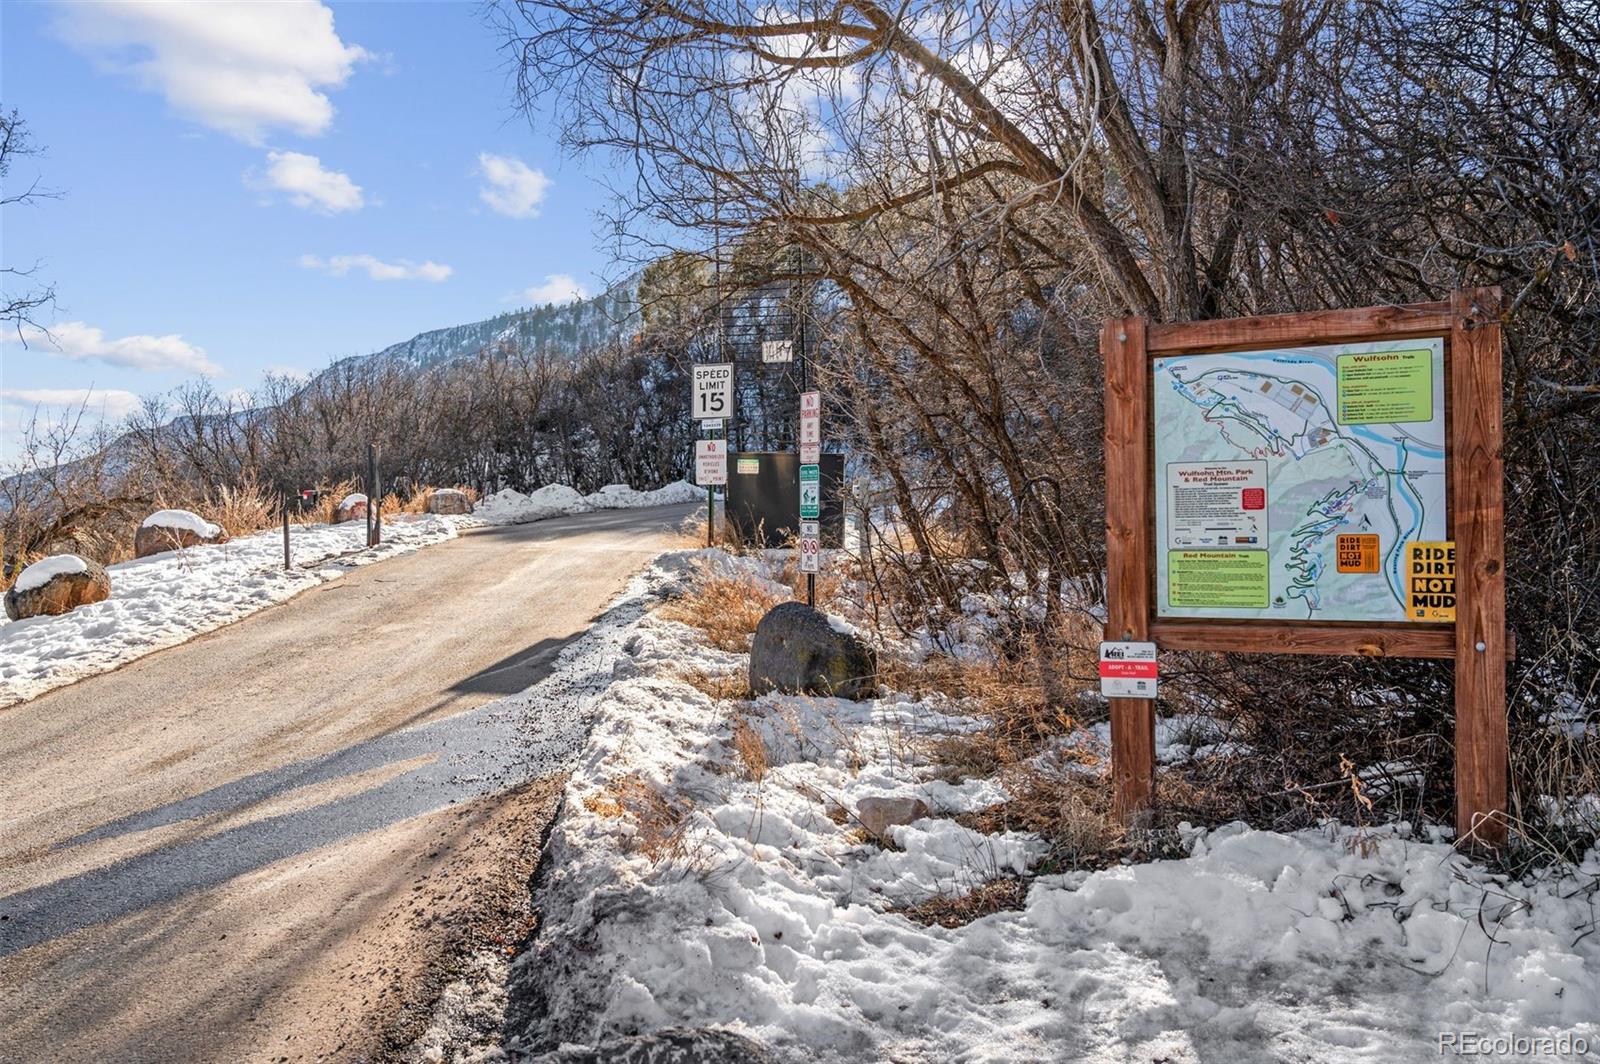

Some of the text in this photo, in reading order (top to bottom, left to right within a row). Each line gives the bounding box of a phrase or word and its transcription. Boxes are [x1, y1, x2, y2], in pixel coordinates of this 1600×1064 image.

[695, 370, 730, 380] SPEED
[699, 381, 726, 390] LIMIT
[700, 392, 725, 412] 15
[707, 443, 717, 452] NO
[1413, 548, 1456, 560] RIDE
[1413, 562, 1456, 574] DIRT
[1414, 579, 1454, 592] NOT
[1412, 595, 1456, 608] MUD
